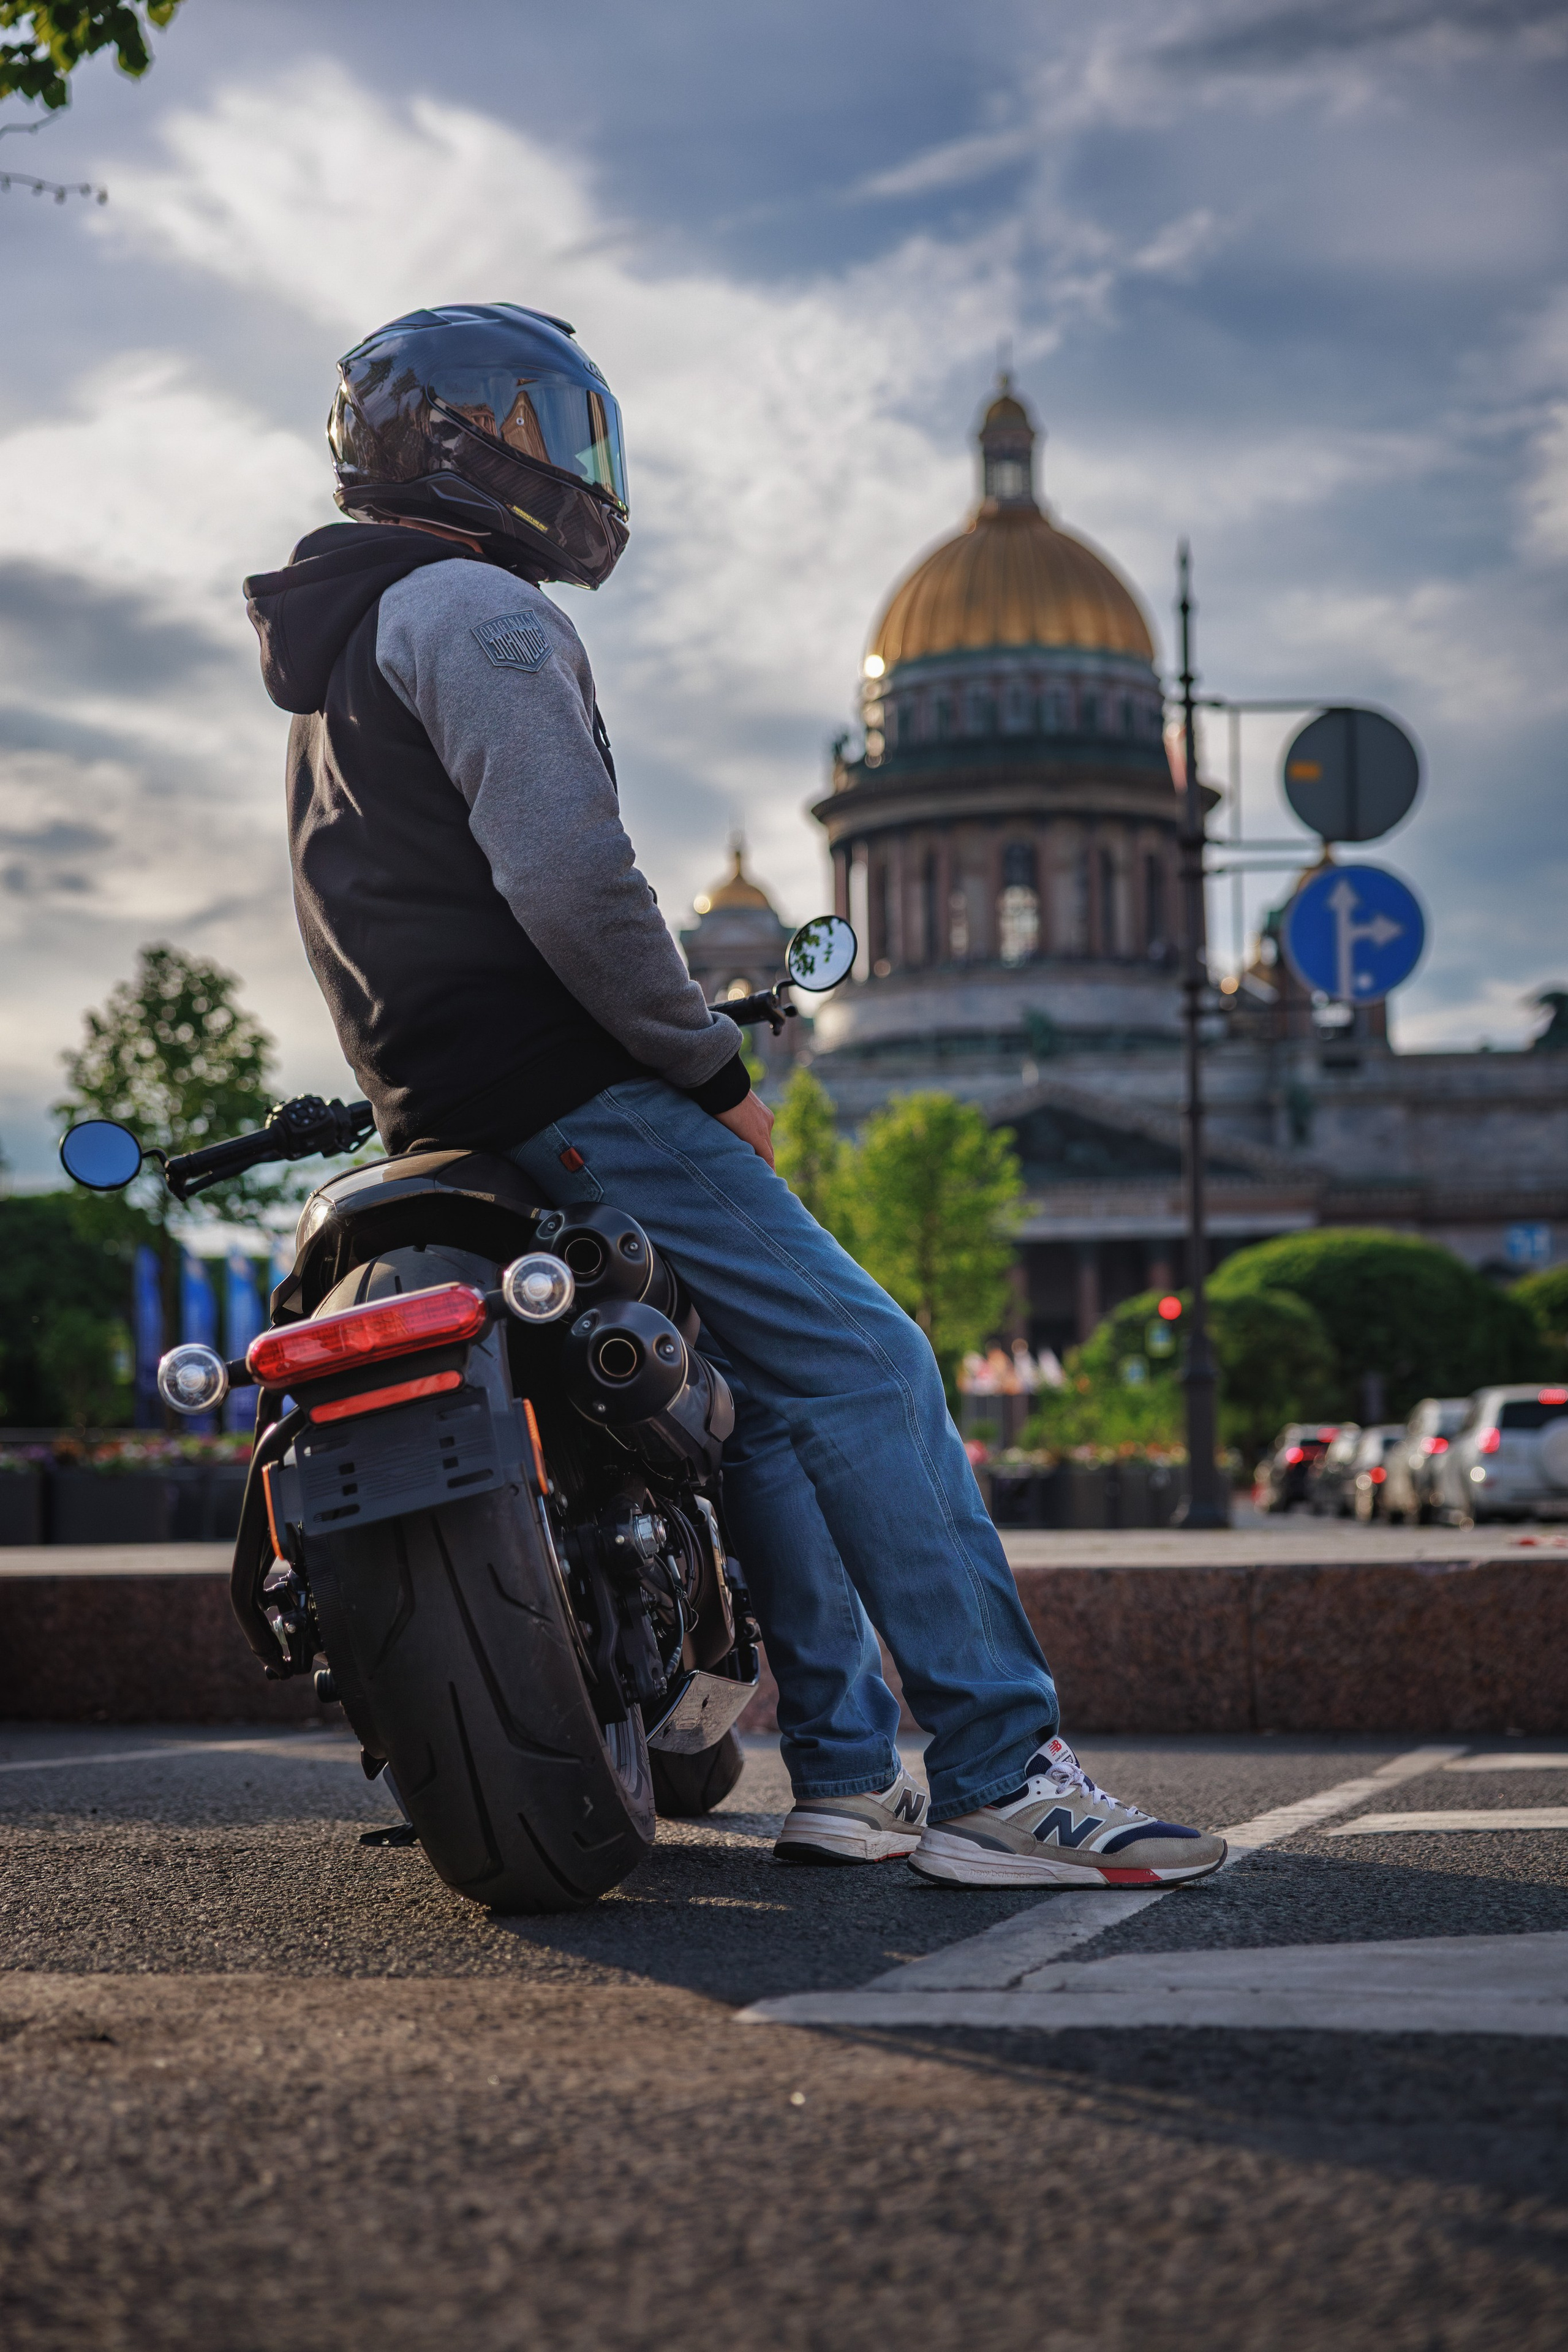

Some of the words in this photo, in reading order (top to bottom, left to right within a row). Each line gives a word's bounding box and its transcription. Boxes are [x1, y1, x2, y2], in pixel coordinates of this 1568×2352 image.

[480, 613, 535, 639] ORIGINALS
[893, 1787, 926, 1824] N
[1031, 1806, 1107, 1849] N
